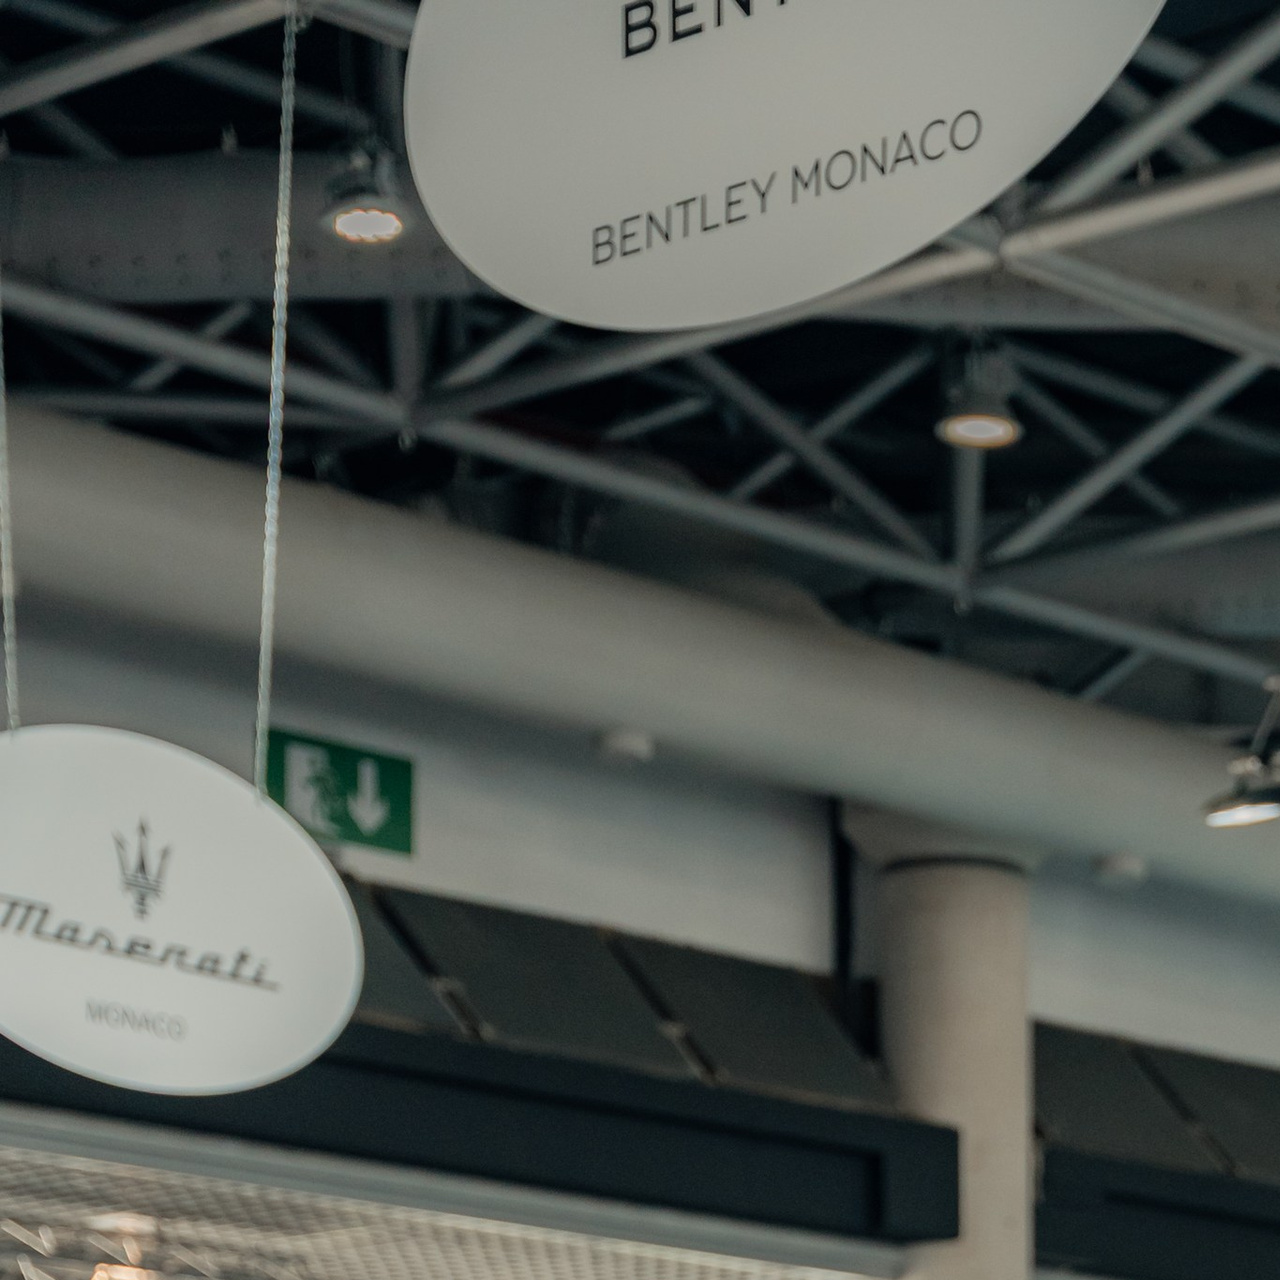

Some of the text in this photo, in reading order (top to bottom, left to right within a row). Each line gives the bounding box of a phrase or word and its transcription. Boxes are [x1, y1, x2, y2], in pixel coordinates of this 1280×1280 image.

[592, 109, 983, 266] BENTLEY MONACO
[0, 893, 281, 992] Maserati
[85, 1000, 188, 1042] MONACO
